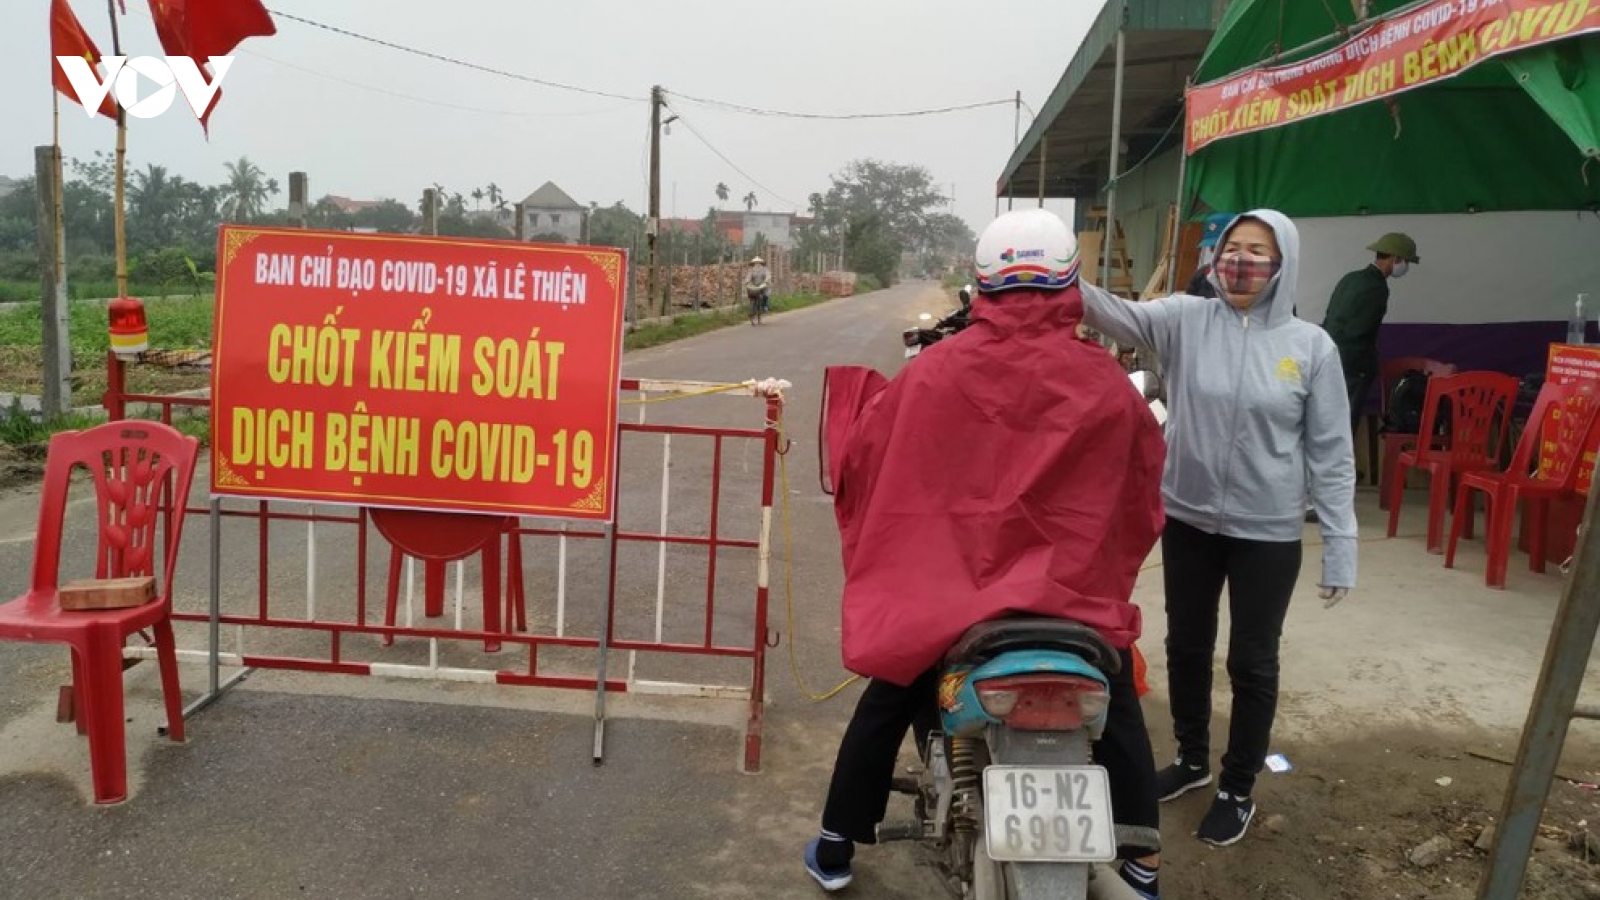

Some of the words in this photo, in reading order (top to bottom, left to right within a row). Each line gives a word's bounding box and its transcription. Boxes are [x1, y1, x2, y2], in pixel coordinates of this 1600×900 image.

[255, 252, 295, 286] BAN
[300, 245, 333, 288] CHỈ
[337, 258, 374, 296] ĐẠO
[380, 259, 468, 296] COVID-19
[472, 261, 499, 298] XÃ
[503, 262, 526, 300] LÊ
[532, 265, 587, 311] THIỆN
[267, 305, 361, 388] CHỐT
[369, 307, 462, 394] KIỂM
[471, 326, 565, 401] SOÁT
[232, 406, 314, 480] DỊCH
[325, 401, 420, 486] BỆNH
[430, 418, 594, 489] COVID-19
[1004, 771, 1092, 810] 16-N2
[1004, 814, 1096, 854] 6992
